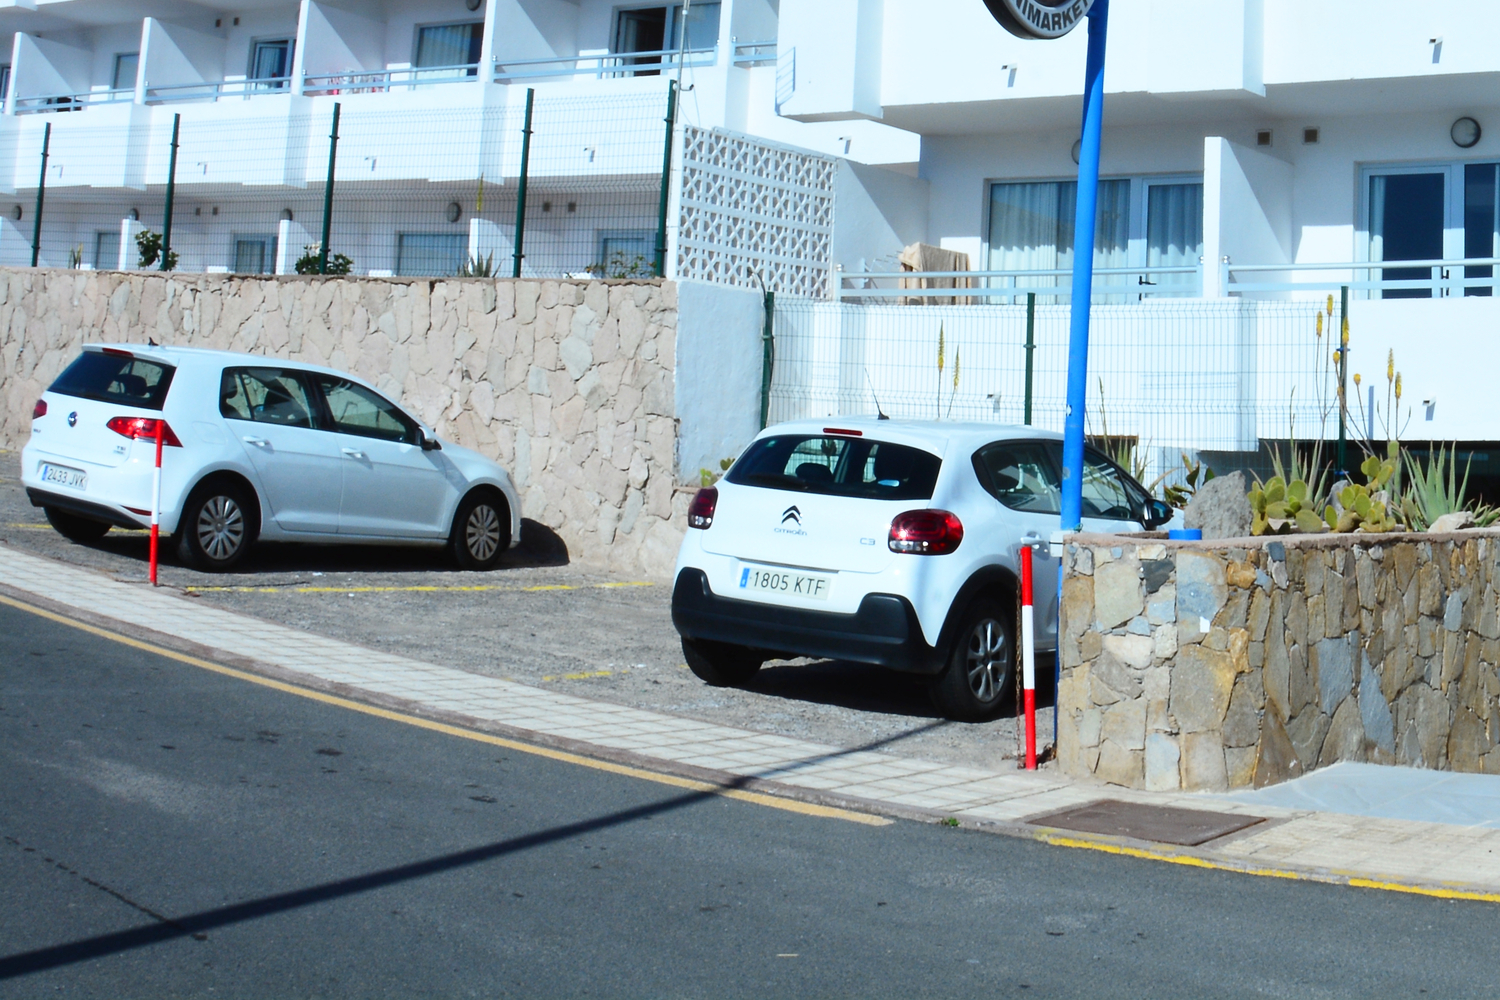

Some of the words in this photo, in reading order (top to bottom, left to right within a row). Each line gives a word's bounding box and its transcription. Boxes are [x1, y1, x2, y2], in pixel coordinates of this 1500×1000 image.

[47, 468, 67, 483] 2433
[69, 472, 86, 487] JVK
[859, 537, 876, 546] C3
[753, 571, 790, 591] 1805
[793, 576, 826, 596] KTF
